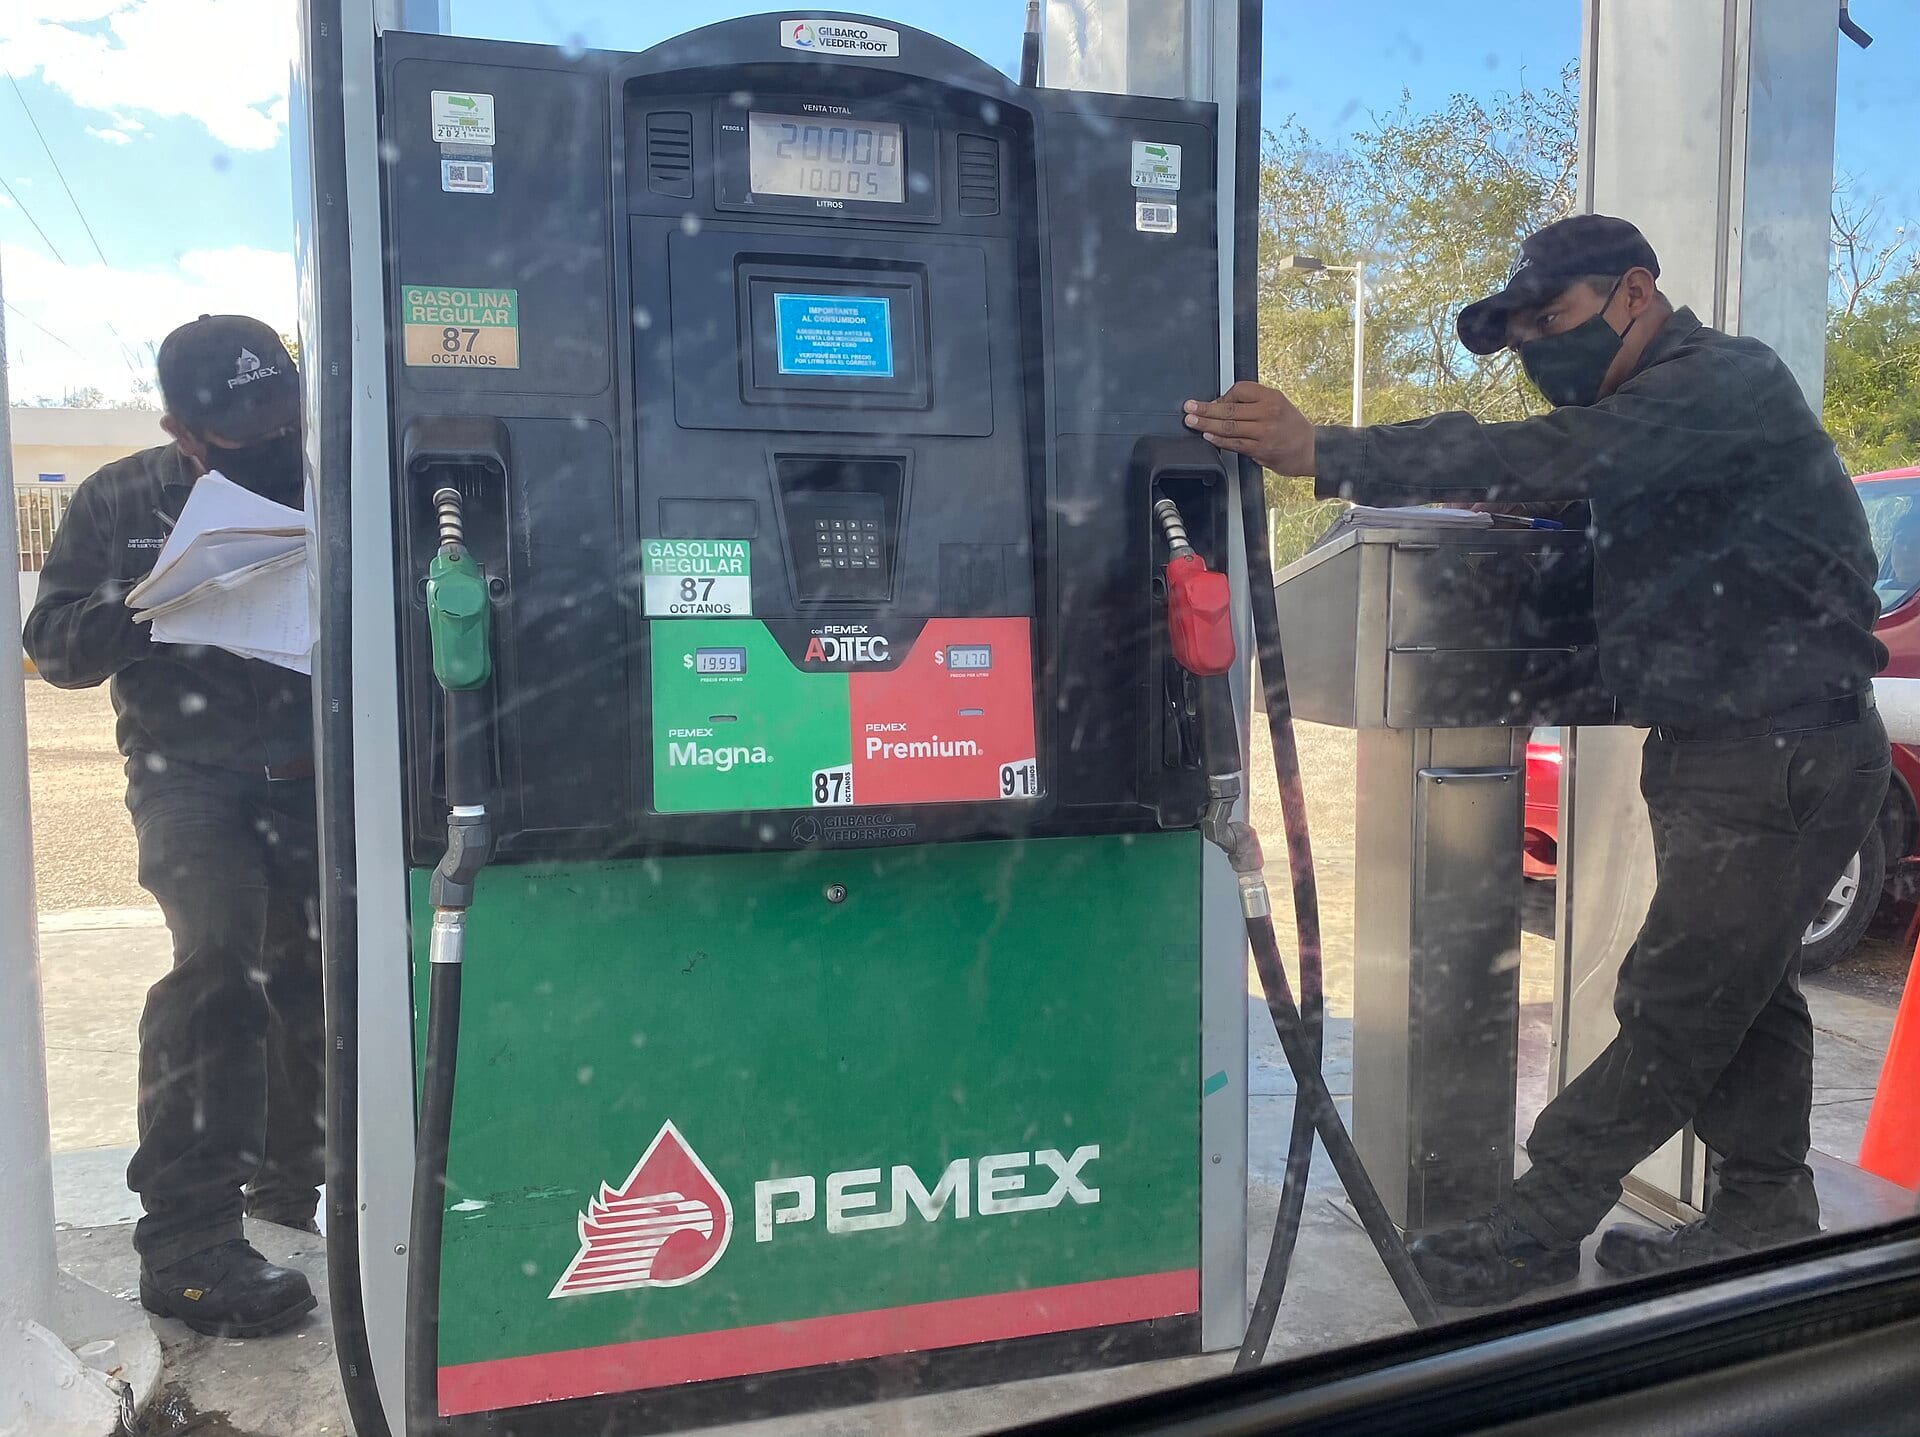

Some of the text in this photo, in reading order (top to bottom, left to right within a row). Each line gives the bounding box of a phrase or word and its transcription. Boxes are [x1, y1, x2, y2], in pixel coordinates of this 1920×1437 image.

[818, 27, 868, 40] GILBARCO
[818, 38, 888, 52] VEEDER-ROOT
[803, 104, 852, 114] VENTA TOTAL
[776, 123, 896, 167] 200.00
[800, 168, 878, 195] 10.005
[816, 200, 844, 208] LITROS
[408, 289, 512, 308] GASOLINA
[412, 306, 508, 324] REGULAR
[808, 306, 859, 316] IMPORTANTE
[814, 315, 866, 324] CONSUMIDOR
[442, 328, 480, 352] 87
[431, 354, 497, 366] OCTANOS
[227, 366, 278, 389] PEMEX
[648, 542, 745, 558] GASOLINA
[651, 558, 742, 573] REGULAR
[680, 578, 716, 602] 87
[670, 604, 732, 614] OCTANOS
[824, 625, 868, 634] PEMEX
[682, 653, 736, 670] $ 19.99
[934, 650, 987, 666] $ 21.70
[668, 728, 714, 738] PEMEX
[866, 722, 907, 732] PEMEX
[815, 772, 844, 804] 87
[1002, 765, 1029, 796] 91
[824, 814, 894, 827] GILBARCO
[824, 826, 917, 842] VEEDER-ROOT
[754, 1143, 1100, 1244] PEMEX
